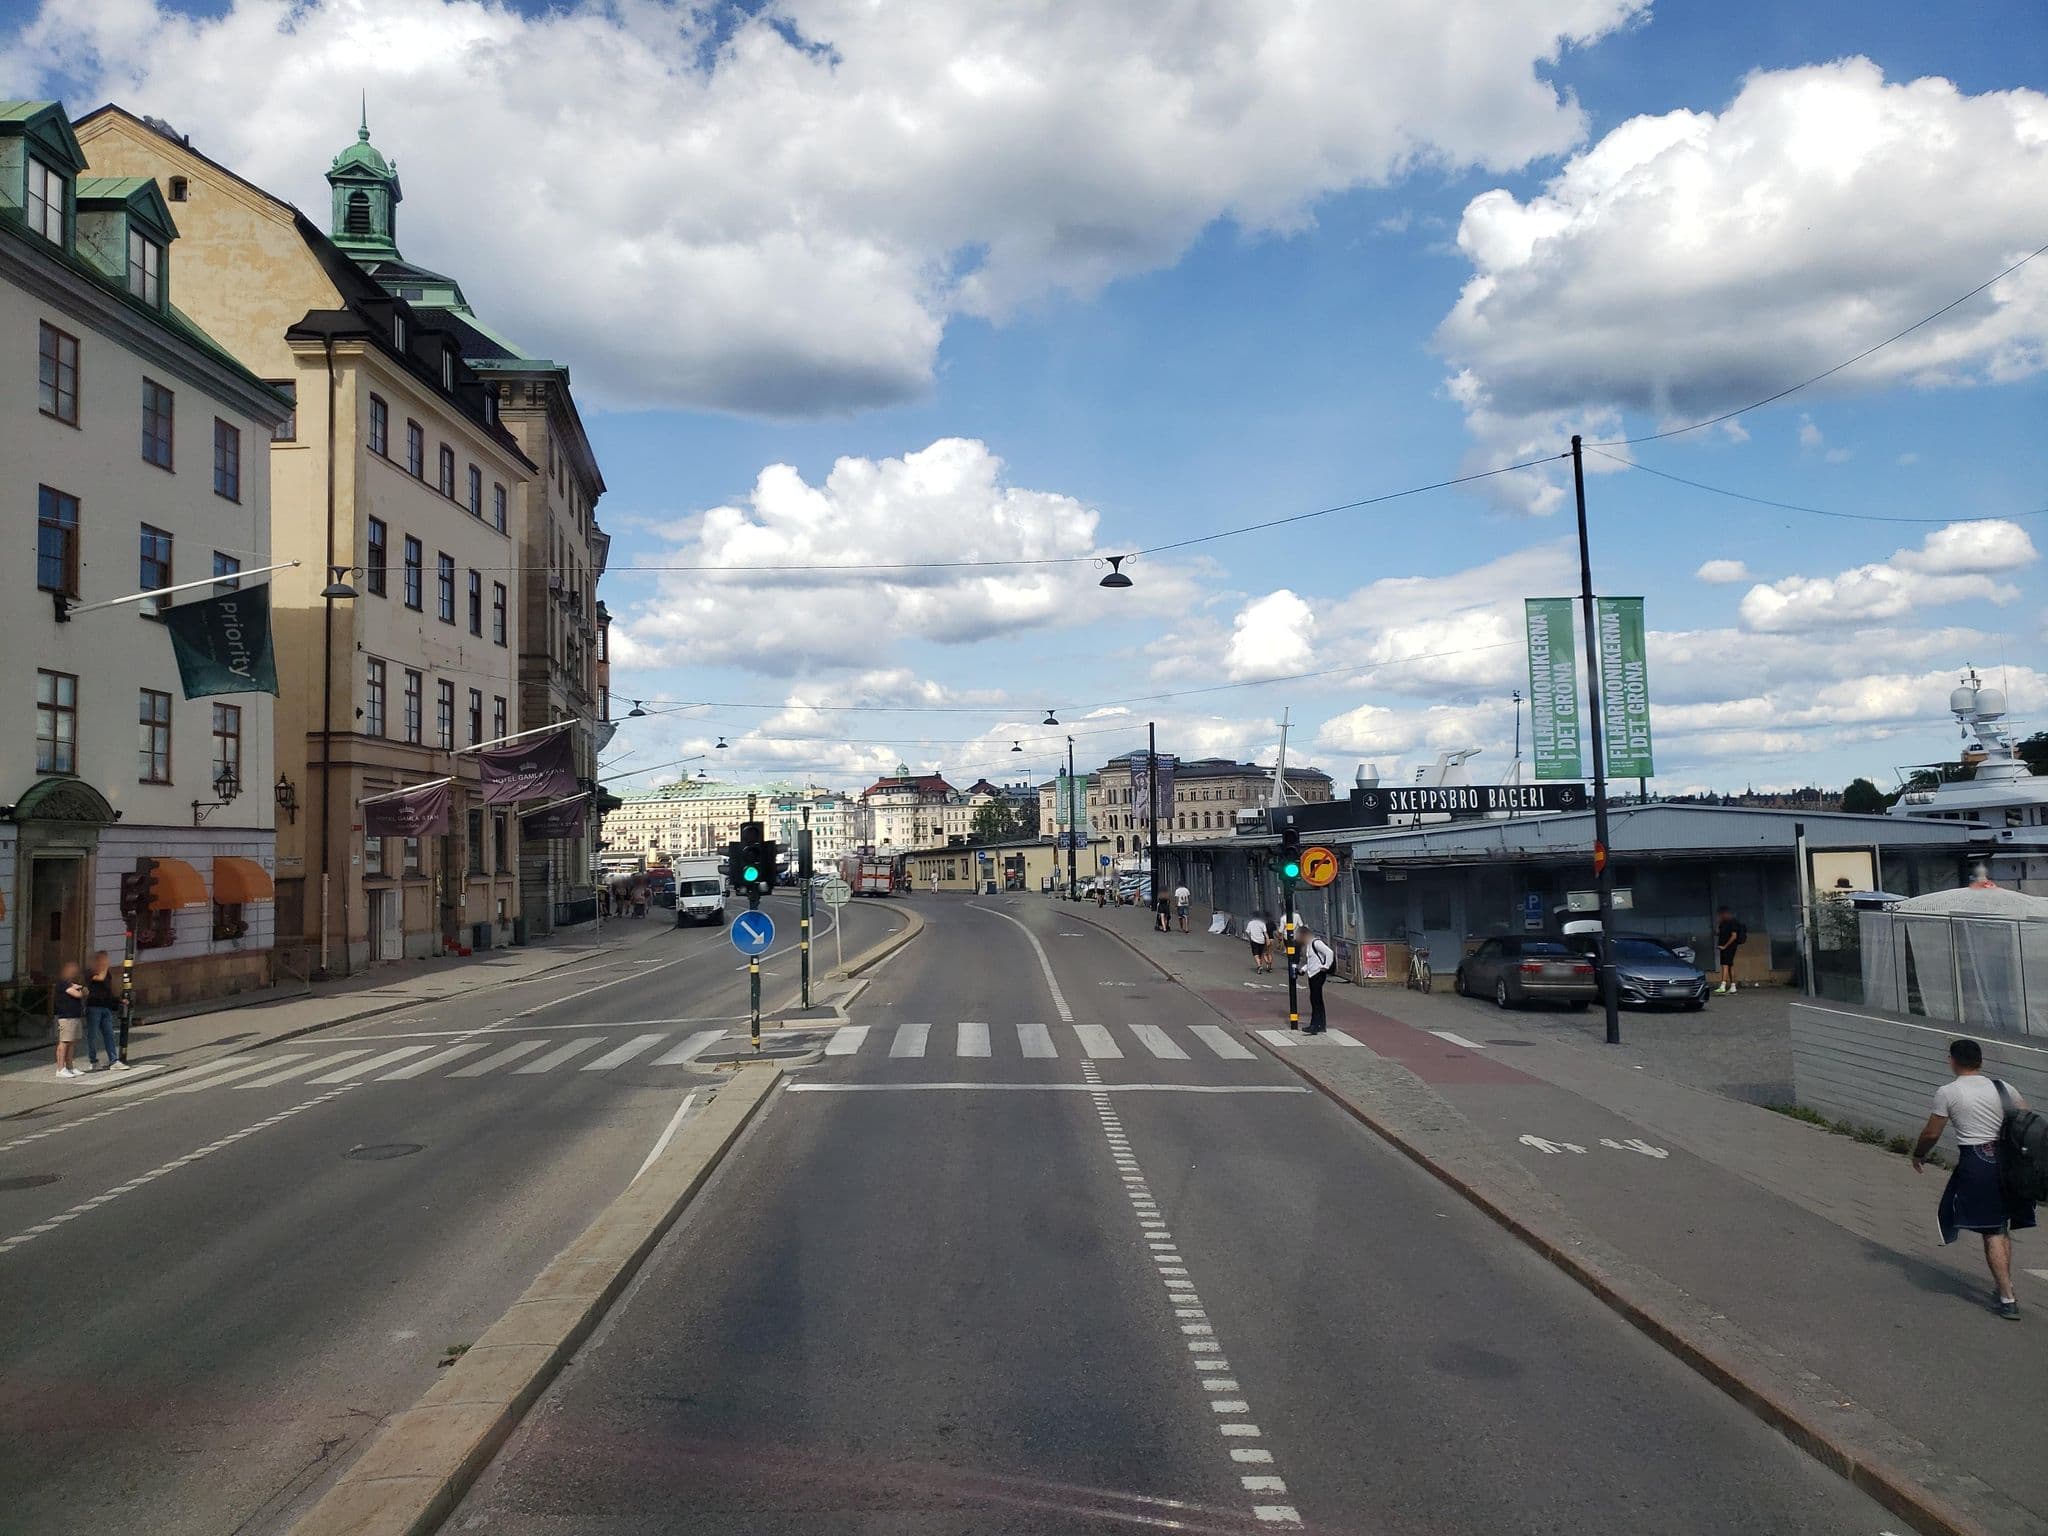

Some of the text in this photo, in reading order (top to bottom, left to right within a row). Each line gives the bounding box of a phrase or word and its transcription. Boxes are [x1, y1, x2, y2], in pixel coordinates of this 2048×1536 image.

[1528, 613, 1556, 760] FILHARMONIKERNA
[1552, 661, 1575, 716] GRÖNA
[1600, 612, 1628, 759] FILHARMONIKERNA
[1624, 660, 1644, 715] GRÖNA
[1556, 720, 1577, 749] DET
[1629, 718, 1649, 748] DET
[518, 773, 543, 782] GAMLA
[1390, 786, 1546, 811] SKEPPSBRO BAGERI
[1529, 895, 1539, 909] P
